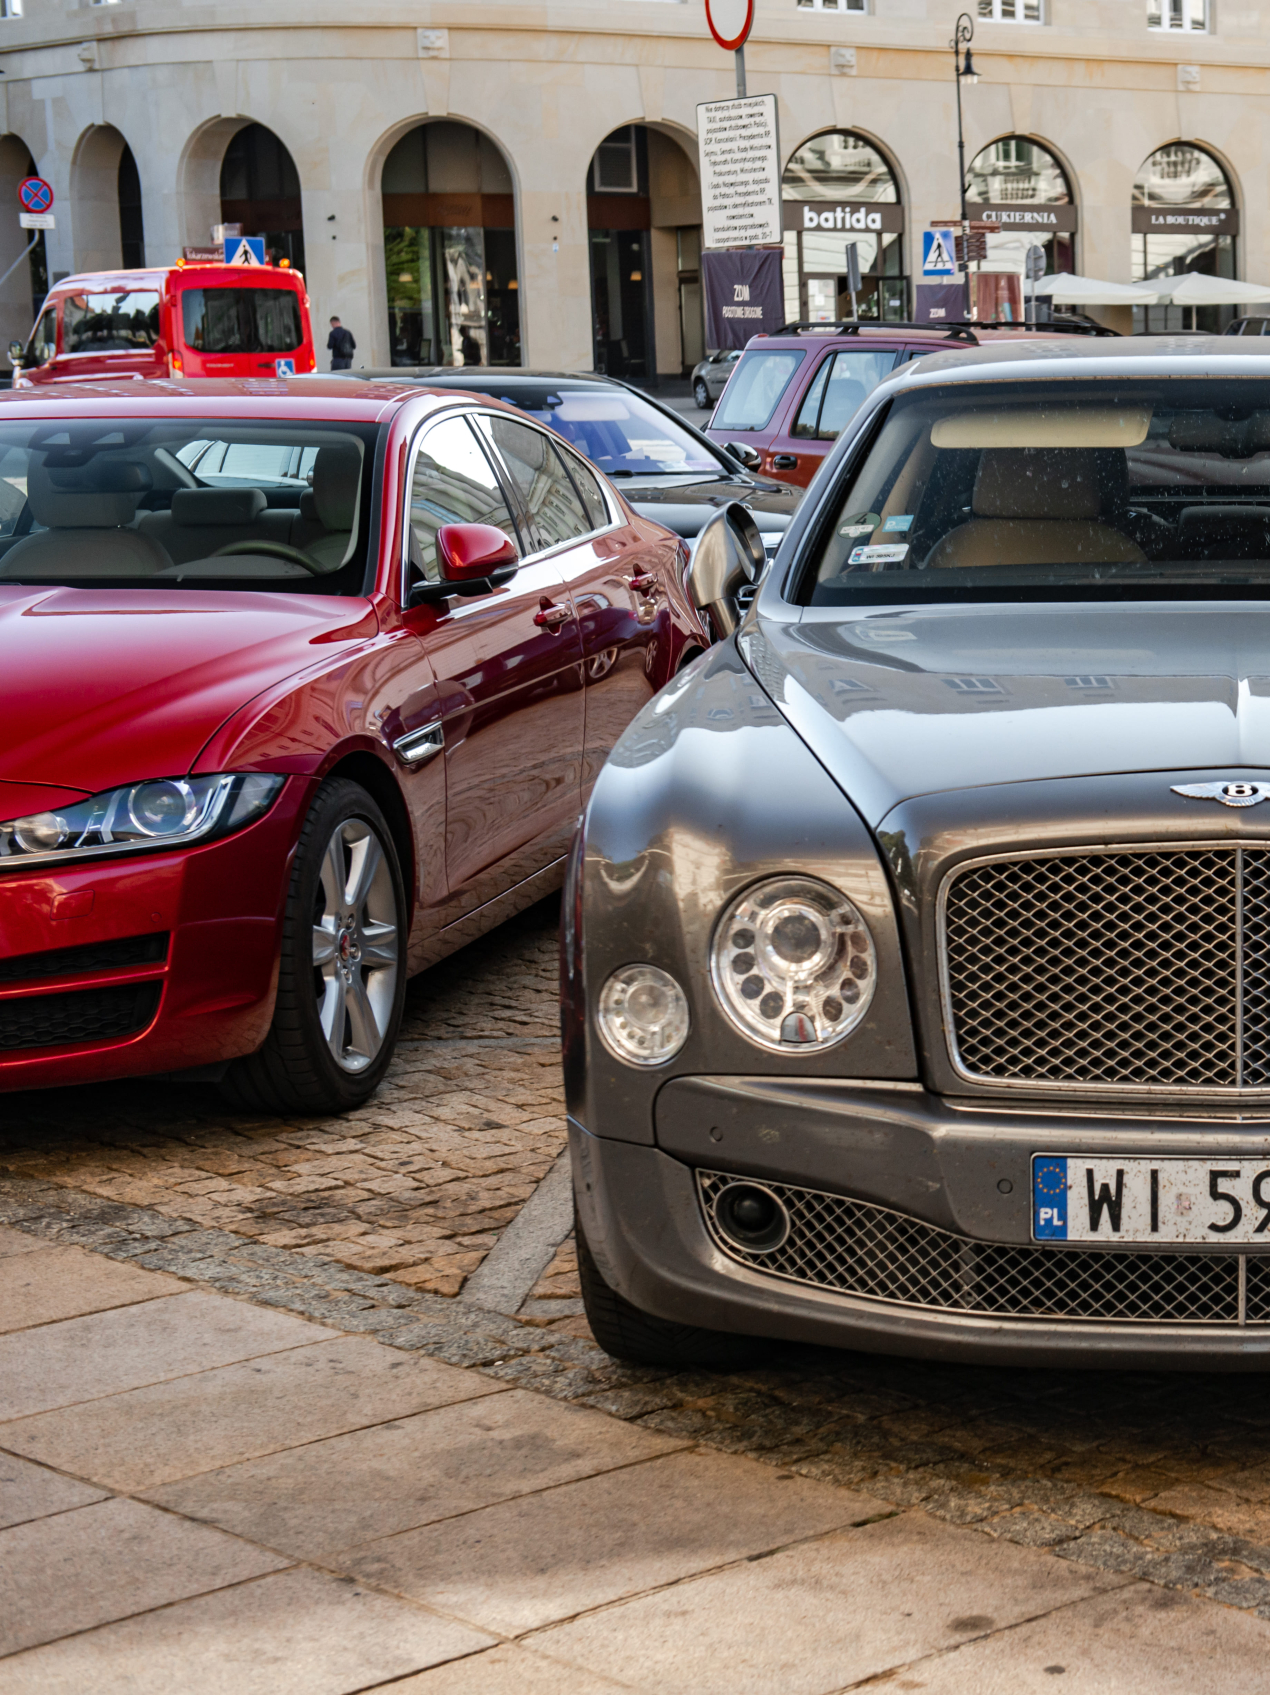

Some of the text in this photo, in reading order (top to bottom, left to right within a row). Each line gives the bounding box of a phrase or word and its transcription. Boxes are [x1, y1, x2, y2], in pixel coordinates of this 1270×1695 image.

[704, 105, 713, 113] Nie
[714, 104, 730, 113] dotyczy
[739, 132, 763, 141] Prezydenta
[738, 145, 748, 155] Rady
[735, 189, 759, 199] Prezydenta
[803, 206, 882, 229] batida
[982, 211, 1057, 223] CUKIERNIA
[1151, 215, 1164, 224] LA
[734, 285, 750, 301] ZDM
[1086, 1168, 1158, 1232] WI
[1039, 1208, 1063, 1226] PL
